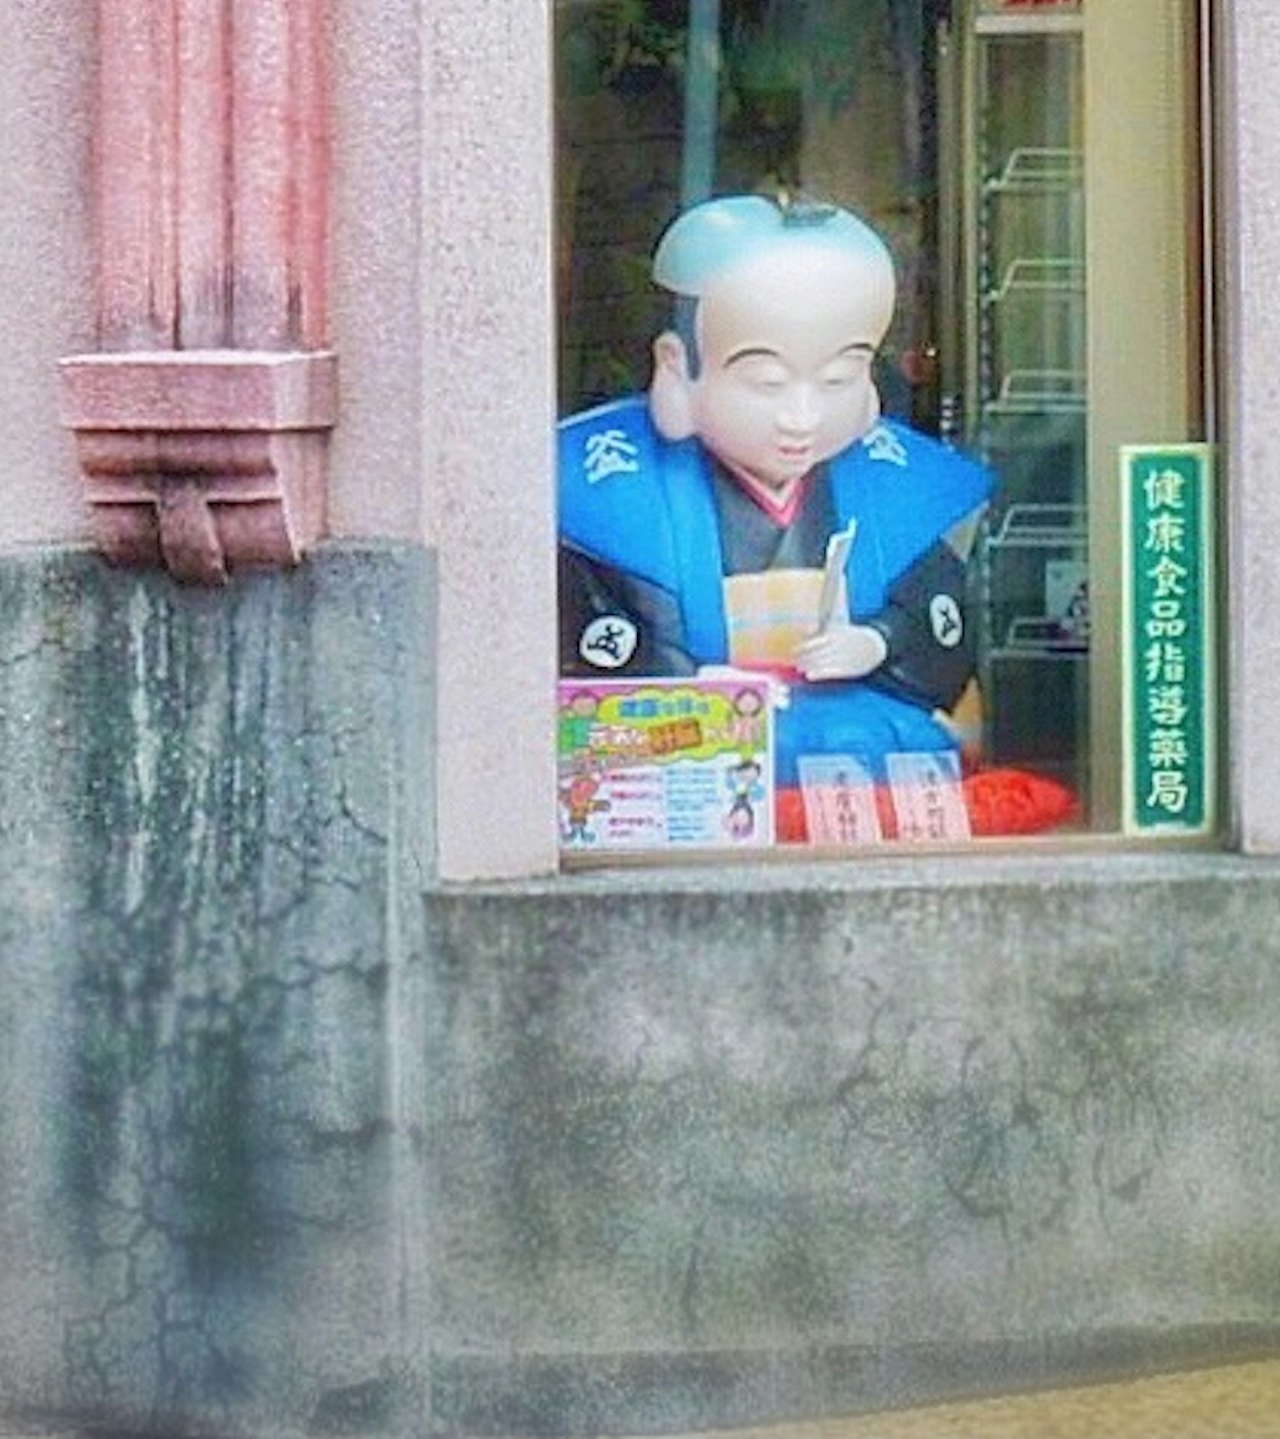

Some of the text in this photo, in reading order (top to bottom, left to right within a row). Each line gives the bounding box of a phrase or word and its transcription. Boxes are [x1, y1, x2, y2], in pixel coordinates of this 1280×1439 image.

[1143, 469, 1189, 814] 健康食品指導薬局
